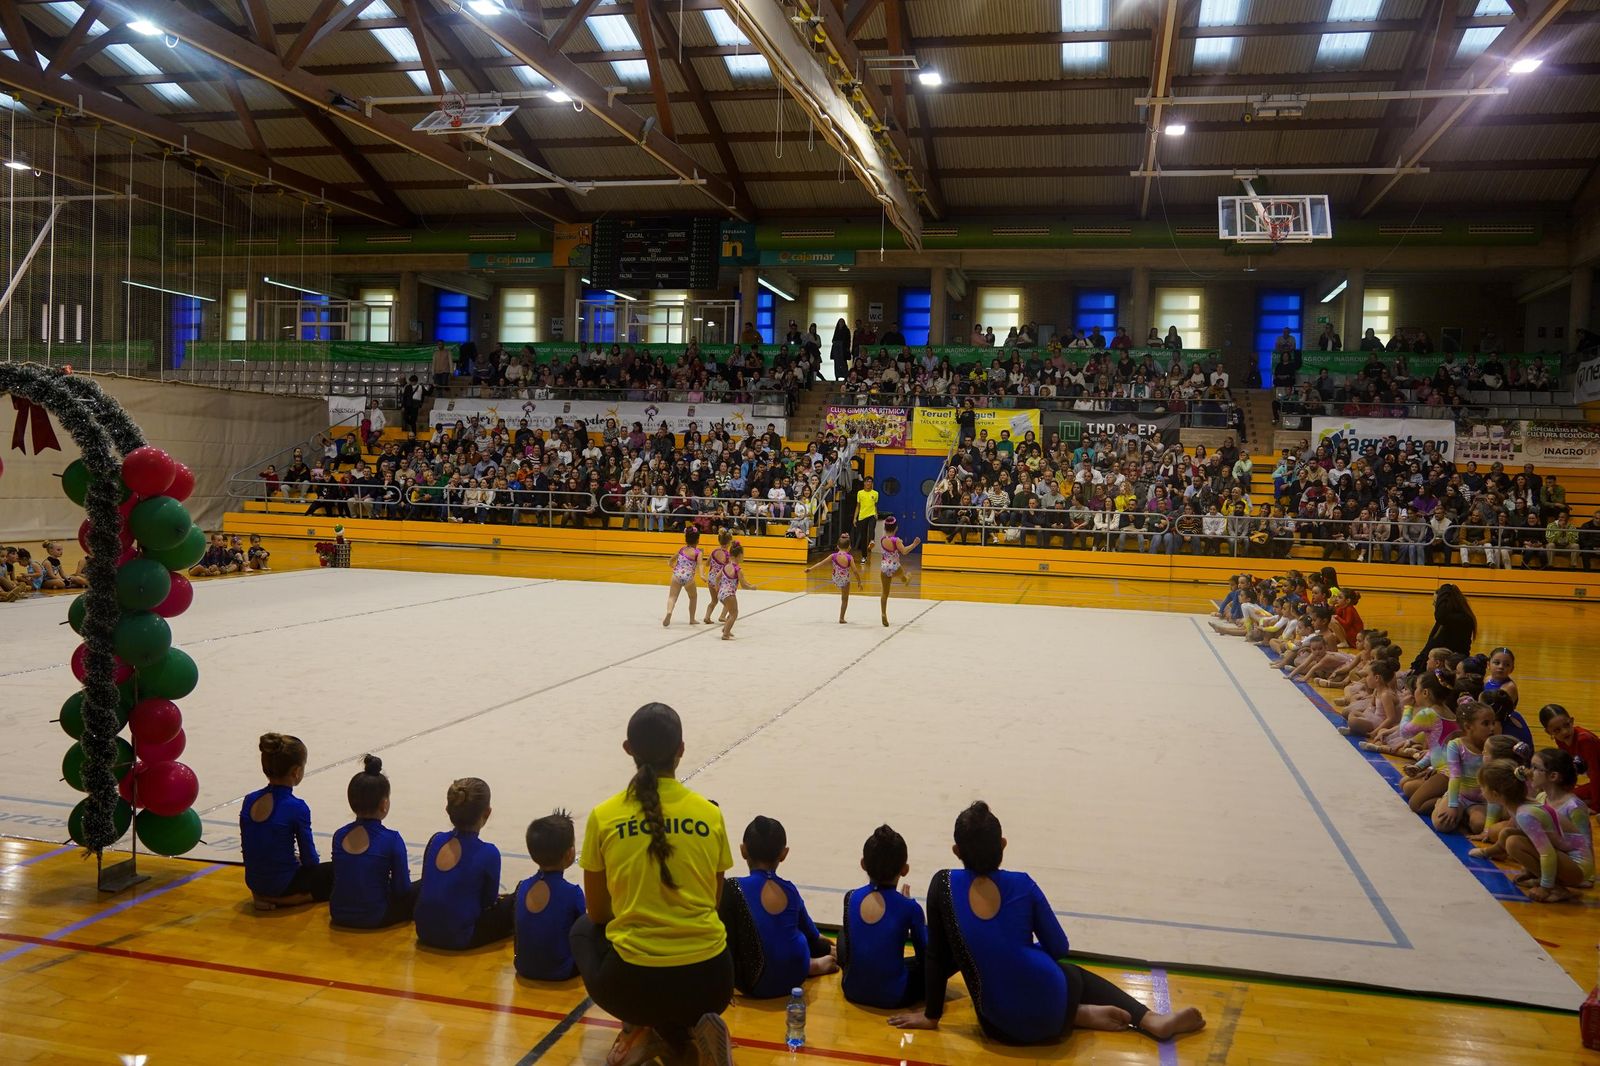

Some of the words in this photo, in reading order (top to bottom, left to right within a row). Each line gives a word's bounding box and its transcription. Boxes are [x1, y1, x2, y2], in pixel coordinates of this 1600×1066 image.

[496, 255, 536, 266] cajamar
[792, 251, 835, 263] cajamar
[847, 407, 878, 415] GIMNASIA
[921, 410, 952, 418] Teruel
[1086, 422, 1157, 436] INDER
[1544, 447, 1598, 456] INAGROUP
